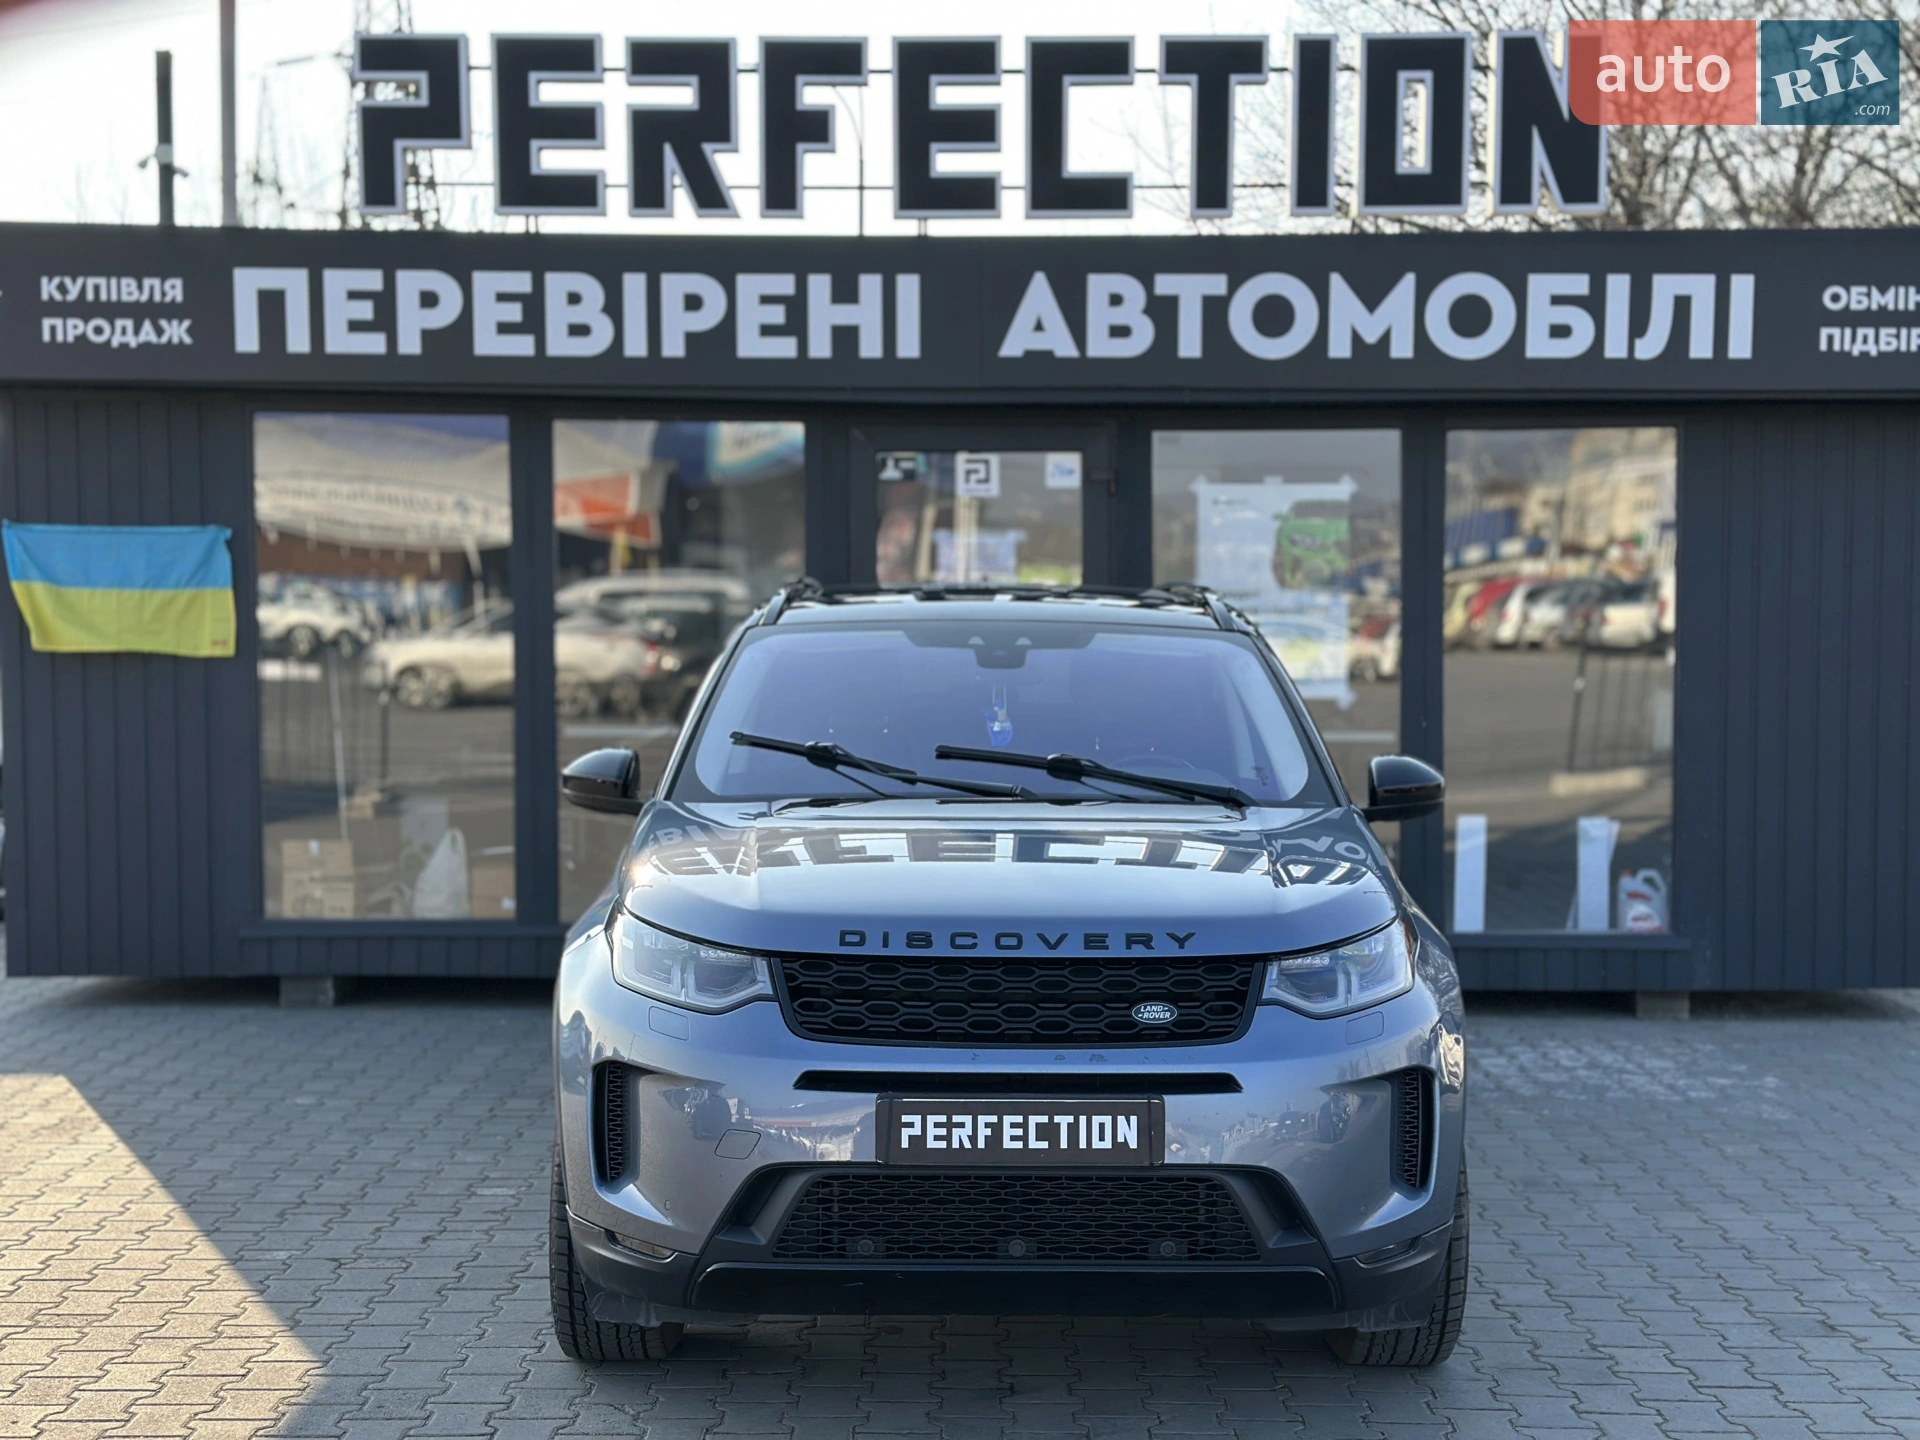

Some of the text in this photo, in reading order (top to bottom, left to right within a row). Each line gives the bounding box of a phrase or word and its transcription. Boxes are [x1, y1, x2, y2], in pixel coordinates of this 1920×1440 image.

[354, 32, 1608, 218] PERFECTION
[40, 275, 184, 303] КУПІВЛЯ
[232, 266, 1756, 362] ПЕРЕВІРЕНІ АВТОМОБІЛІ
[41, 316, 194, 349] ПРОДАЖ
[838, 929, 1197, 951] DISCOVERY
[901, 1114, 1138, 1149] PERFECTION
